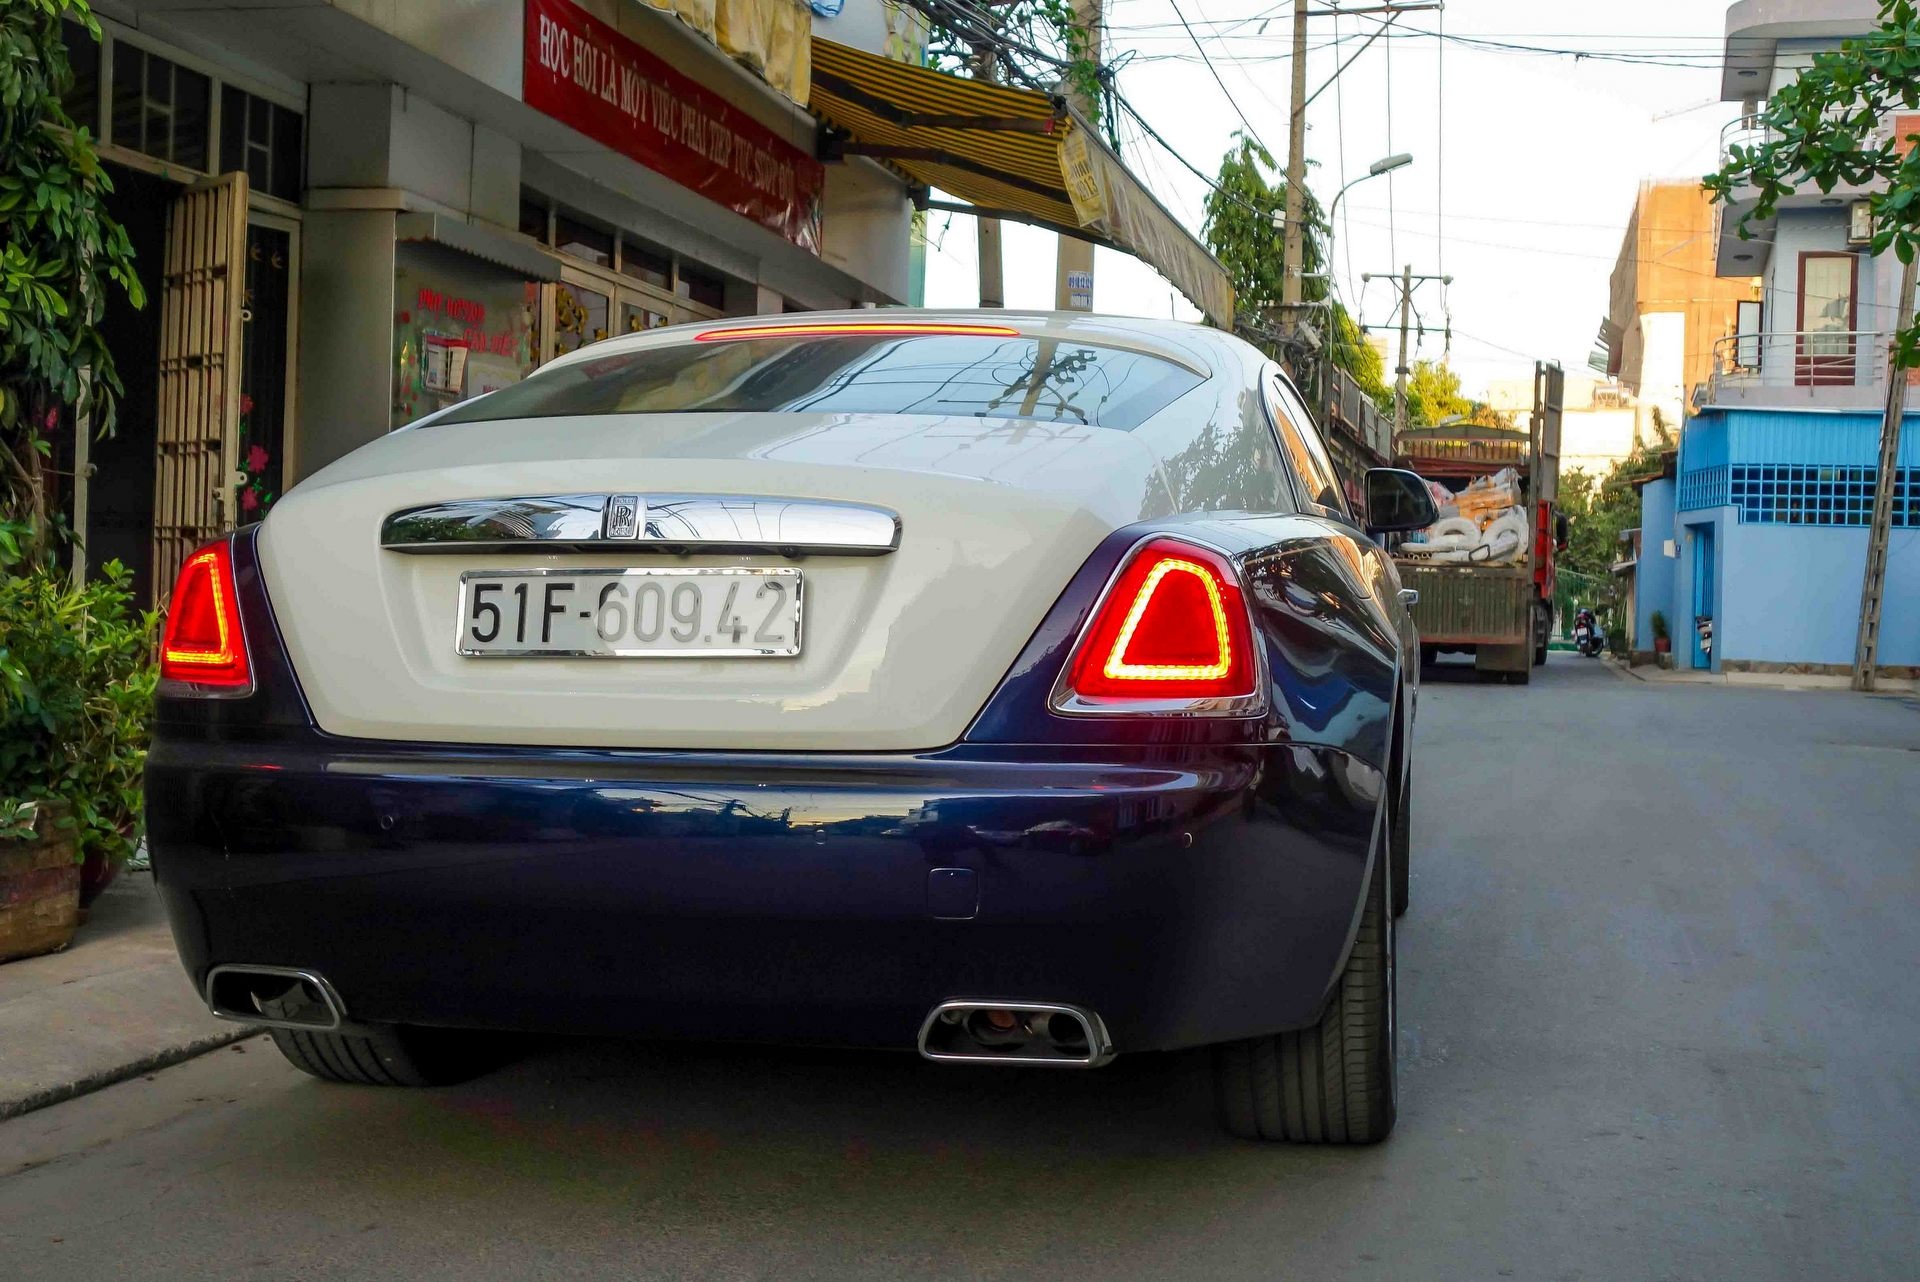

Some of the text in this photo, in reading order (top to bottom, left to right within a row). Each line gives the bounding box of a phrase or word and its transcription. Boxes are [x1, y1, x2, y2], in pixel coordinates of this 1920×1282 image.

[539, 14, 569, 84] HỌC
[573, 24, 598, 95] HỎI
[601, 44, 617, 104] LÀ
[620, 60, 648, 128] MỘT
[651, 80, 679, 144] VIỆC
[472, 582, 785, 643] 51F-609.42
